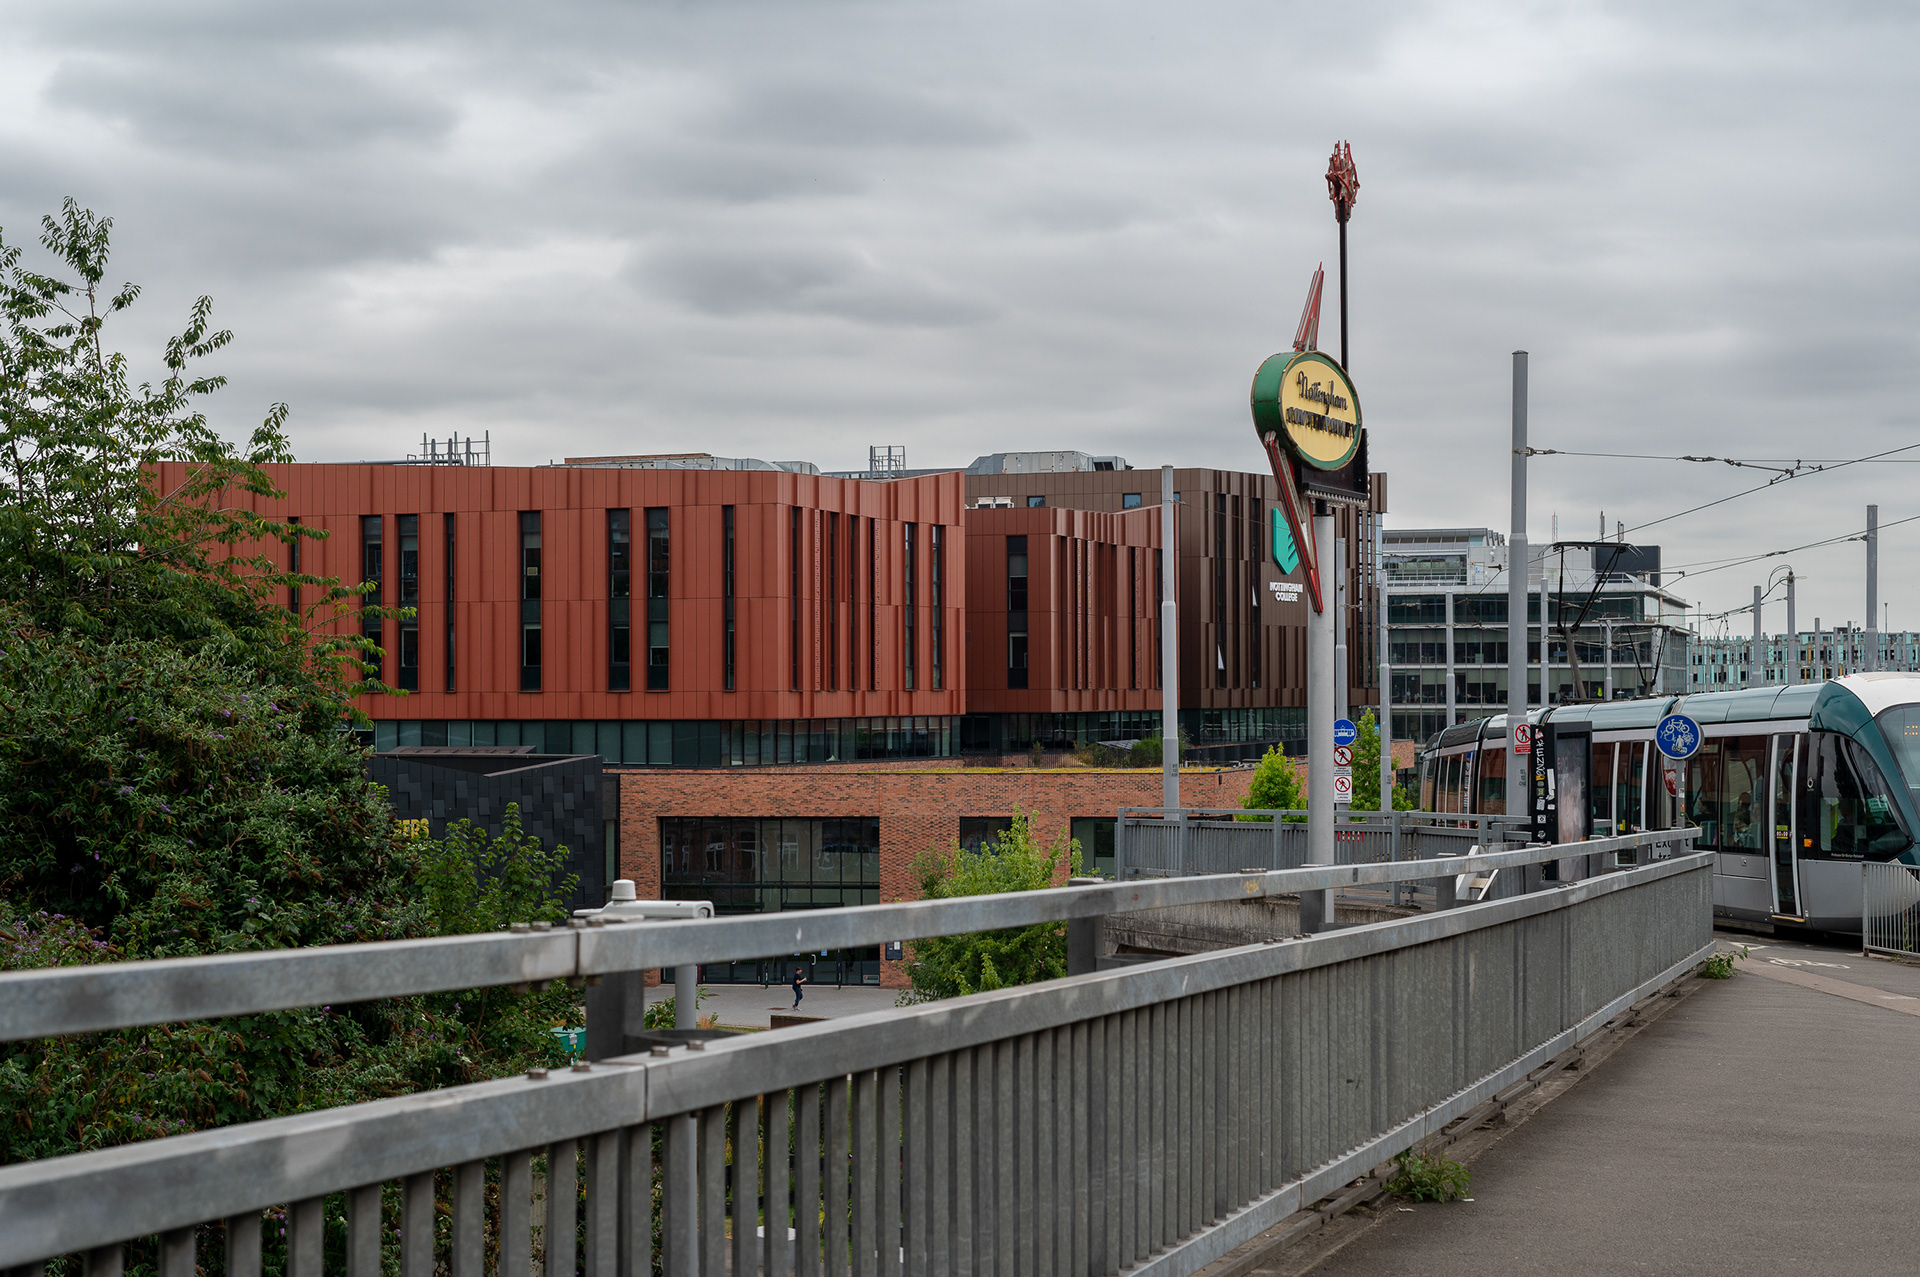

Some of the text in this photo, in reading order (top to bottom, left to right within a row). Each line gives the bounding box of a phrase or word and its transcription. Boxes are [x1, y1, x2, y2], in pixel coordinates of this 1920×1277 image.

[1296, 370, 1348, 415] Nottingham
[1286, 406, 1357, 440] CONTEMPORARY
[1269, 581, 1303, 593] NOTTINGHAM
[1275, 591, 1298, 602] COLLEGE
